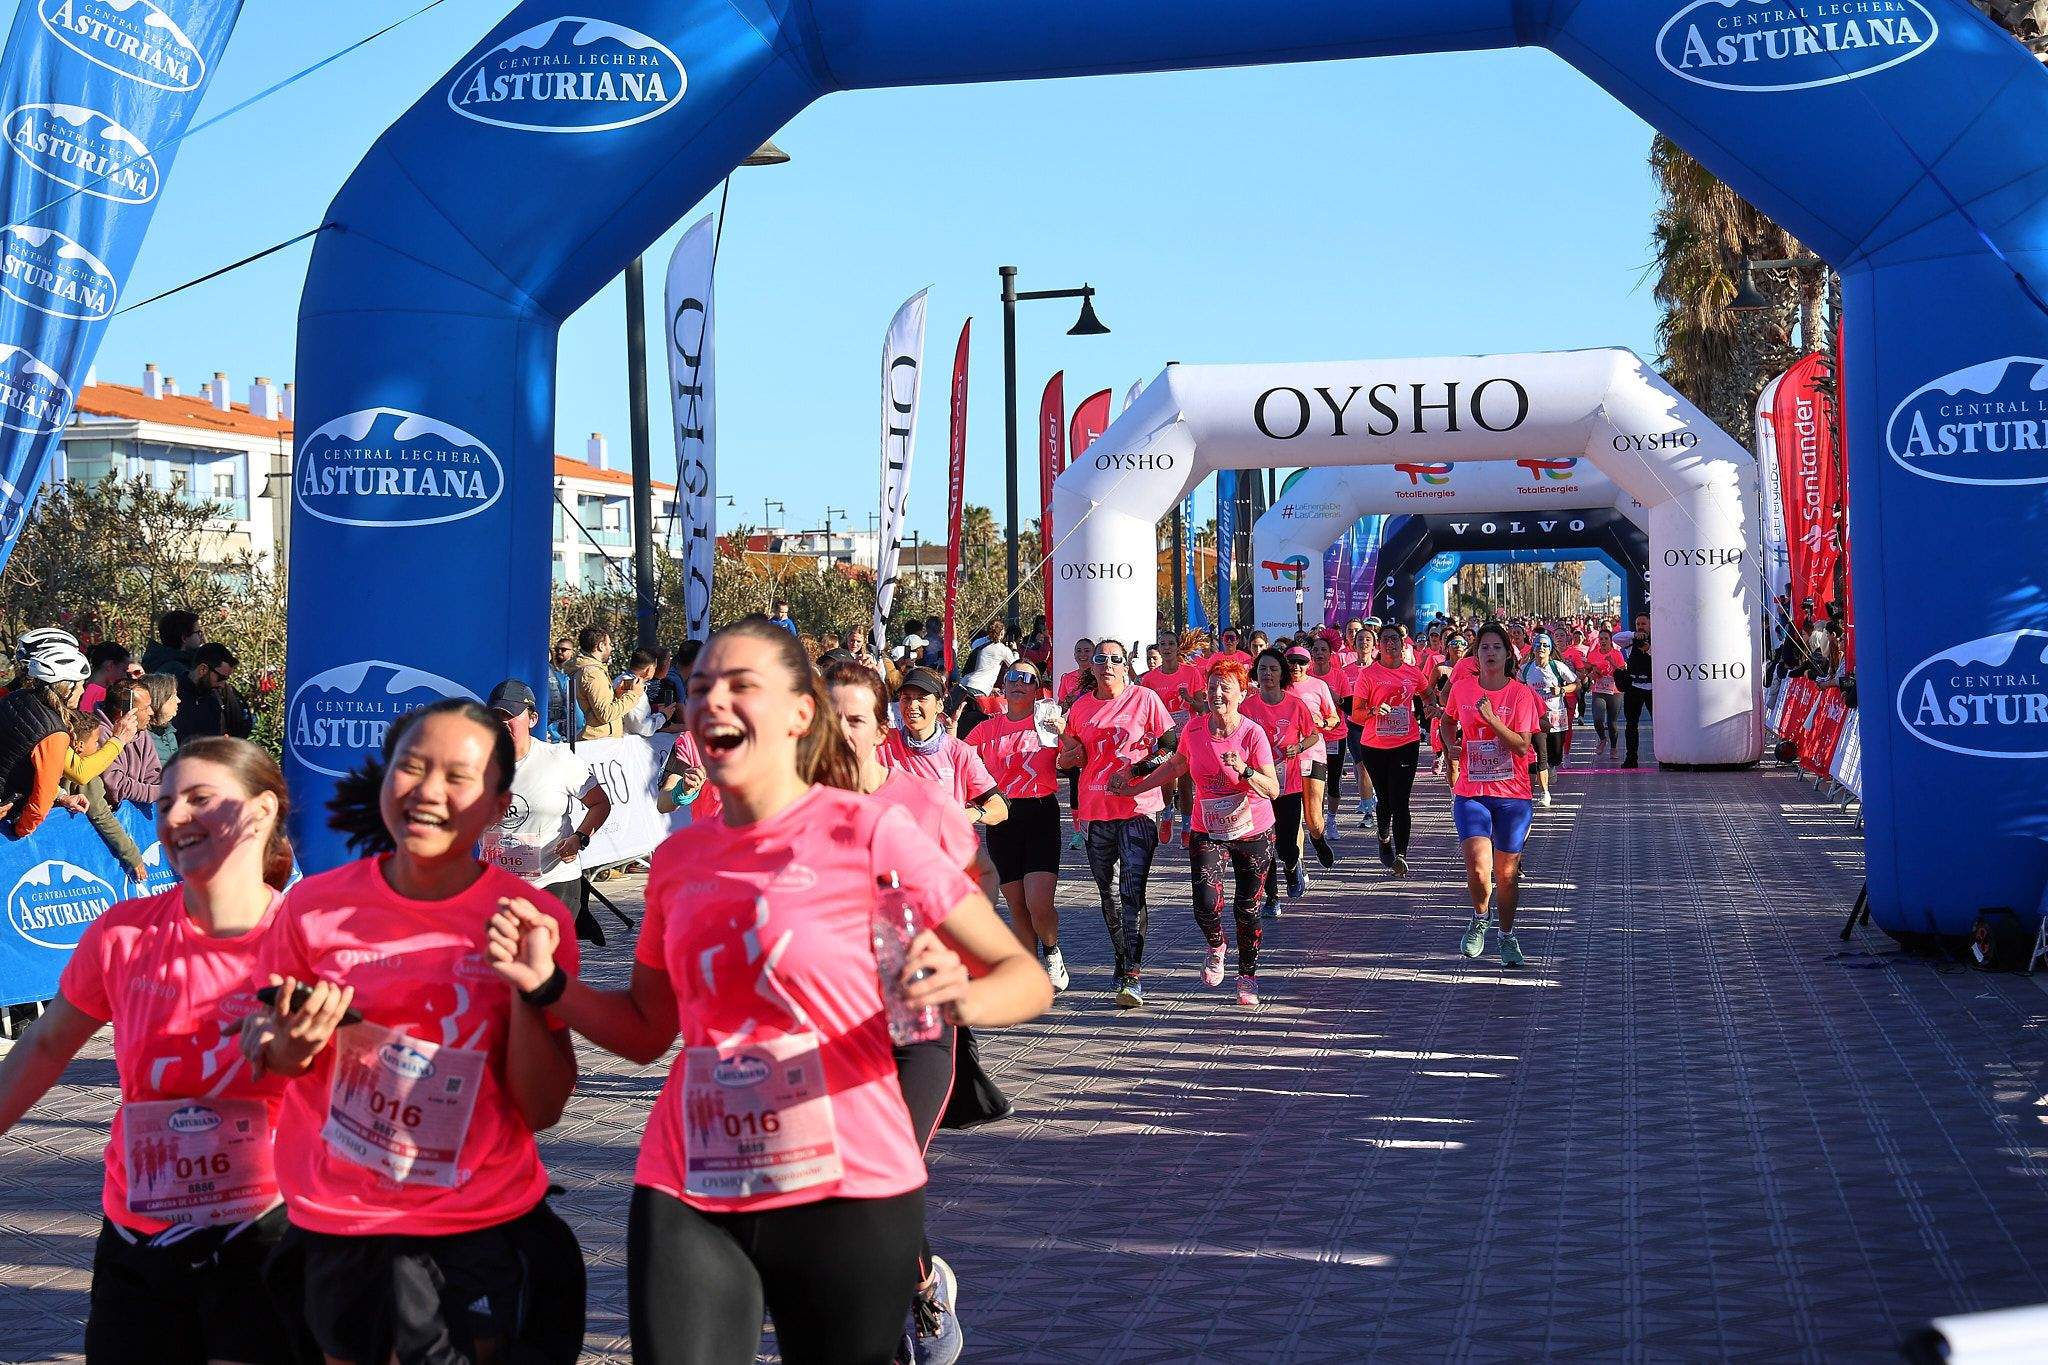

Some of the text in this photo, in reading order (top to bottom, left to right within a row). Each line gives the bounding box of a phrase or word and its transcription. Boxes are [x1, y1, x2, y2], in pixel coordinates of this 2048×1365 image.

[1717, 1, 1905, 29] CENTRAL LECHERA
[49, 0, 189, 85] ASTURIANA
[85, 4, 192, 63] CENTRAL LECHERA
[1678, 17, 1922, 69] ASTURIANA
[499, 53, 660, 70] CENTRAL LECHERA
[459, 66, 668, 106] ASTURIANA
[14, 115, 148, 198] ASTURIANA
[43, 121, 151, 174] CENTRAL LECHERA
[0, 240, 106, 315] STURIANA
[10, 242, 109, 290] CENTRAL LECHERA
[1252, 377, 1530, 441] OYSHO
[1939, 401, 2029, 418] CENTRAL
[1612, 431, 1699, 453] OYSHO
[324, 449, 481, 464] CENTRAL LECHERA
[1095, 453, 1174, 471] OYSHO
[1794, 396, 1822, 521] Santander
[301, 452, 488, 499] ASTURIANA
[1394, 489, 1456, 500] TotalEnergies
[1516, 484, 1579, 496] TotalEnergies
[1449, 519, 1585, 535] VOLVO
[1663, 547, 1743, 567] OYSHO
[1060, 562, 1133, 581] OYSHO
[1262, 585, 1310, 594] TotalEneres
[1666, 661, 1746, 681] OYSHO
[1950, 674, 2040, 688] CENTRAL
[316, 700, 385, 713] CENTRAL
[1913, 678, 2048, 726] ASTUR
[293, 702, 392, 748] ASTUR
[1482, 757, 1499, 766] 016
[1220, 815, 1238, 825] 016
[500, 856, 523, 866] 016
[31, 884, 103, 902] CENTRAL LECHERA
[19, 896, 111, 931] ASTURIANA
[369, 1090, 423, 1129] 016
[723, 1108, 780, 1138] 016
[175, 1152, 231, 1179] 016
